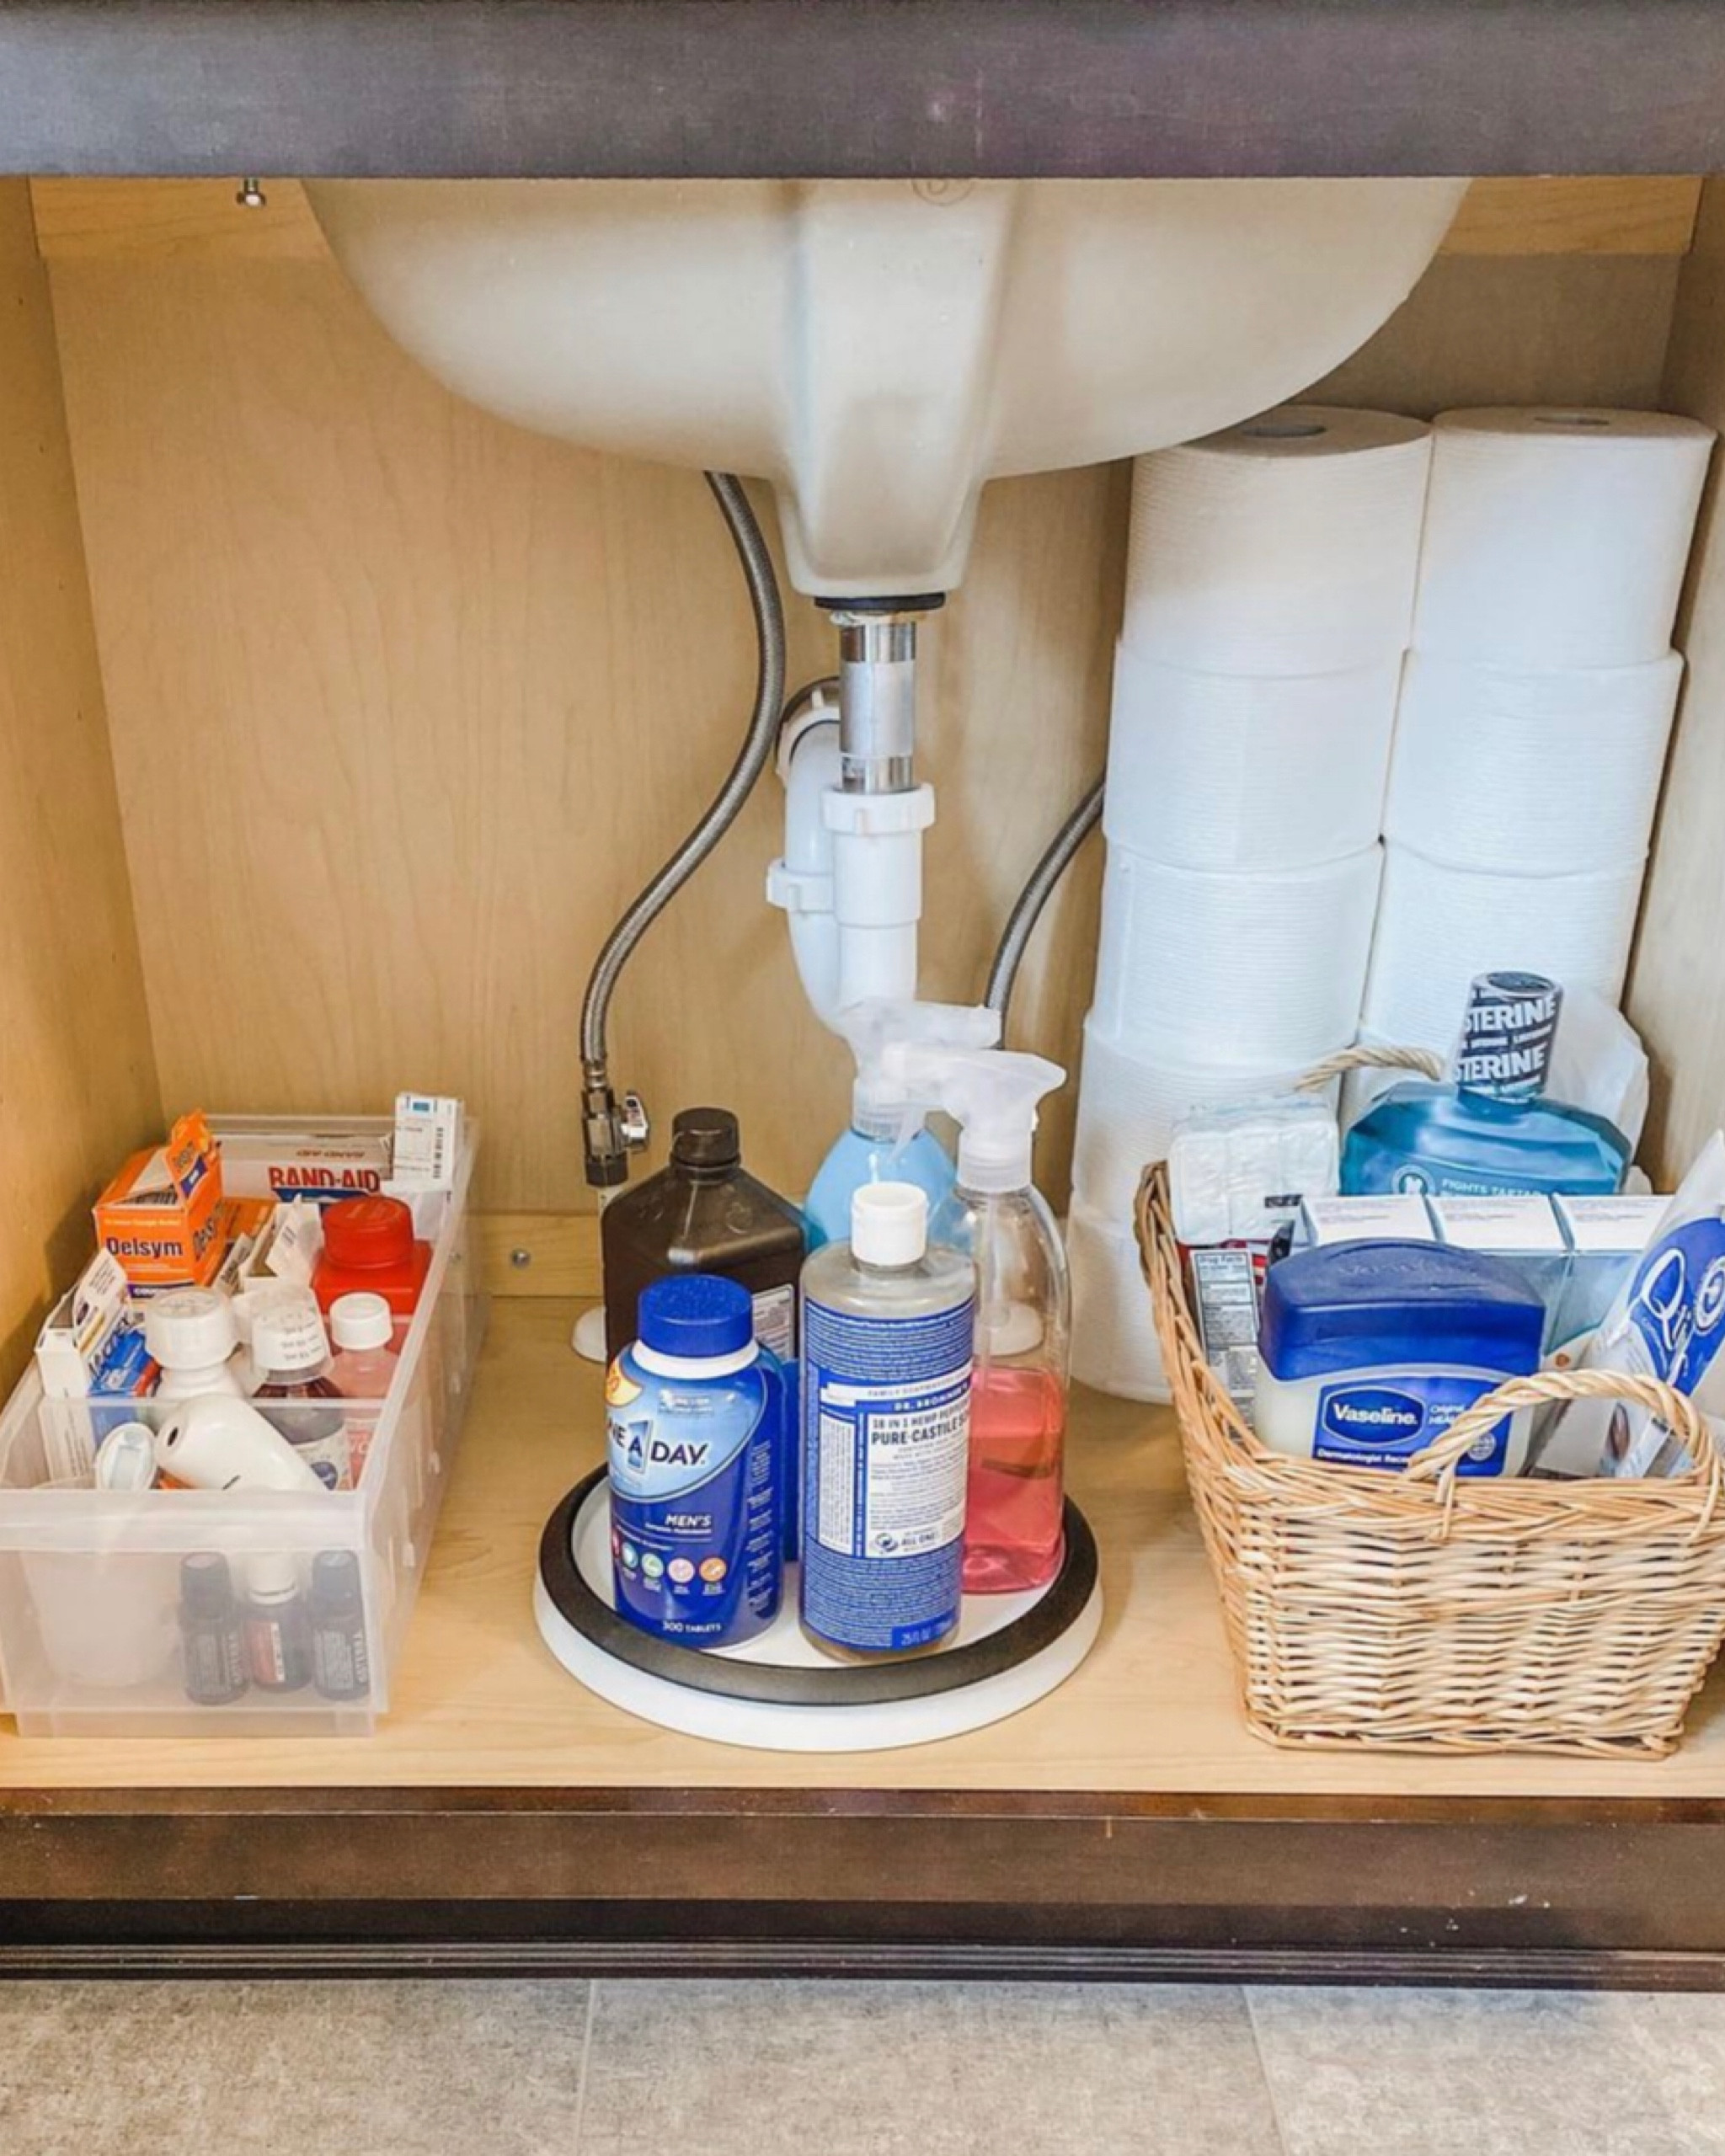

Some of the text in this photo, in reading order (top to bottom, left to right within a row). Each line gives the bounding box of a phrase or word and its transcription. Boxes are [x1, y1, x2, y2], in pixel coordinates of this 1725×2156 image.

[269, 1166, 380, 1193] BAND-AID
[1492, 1187, 1541, 1196] TARTA
[106, 1236, 183, 1259] Delsym
[1333, 1403, 1418, 1424] Vaseline
[651, 1440, 708, 1465] DAY
[665, 1513, 712, 1526] MEN'S
